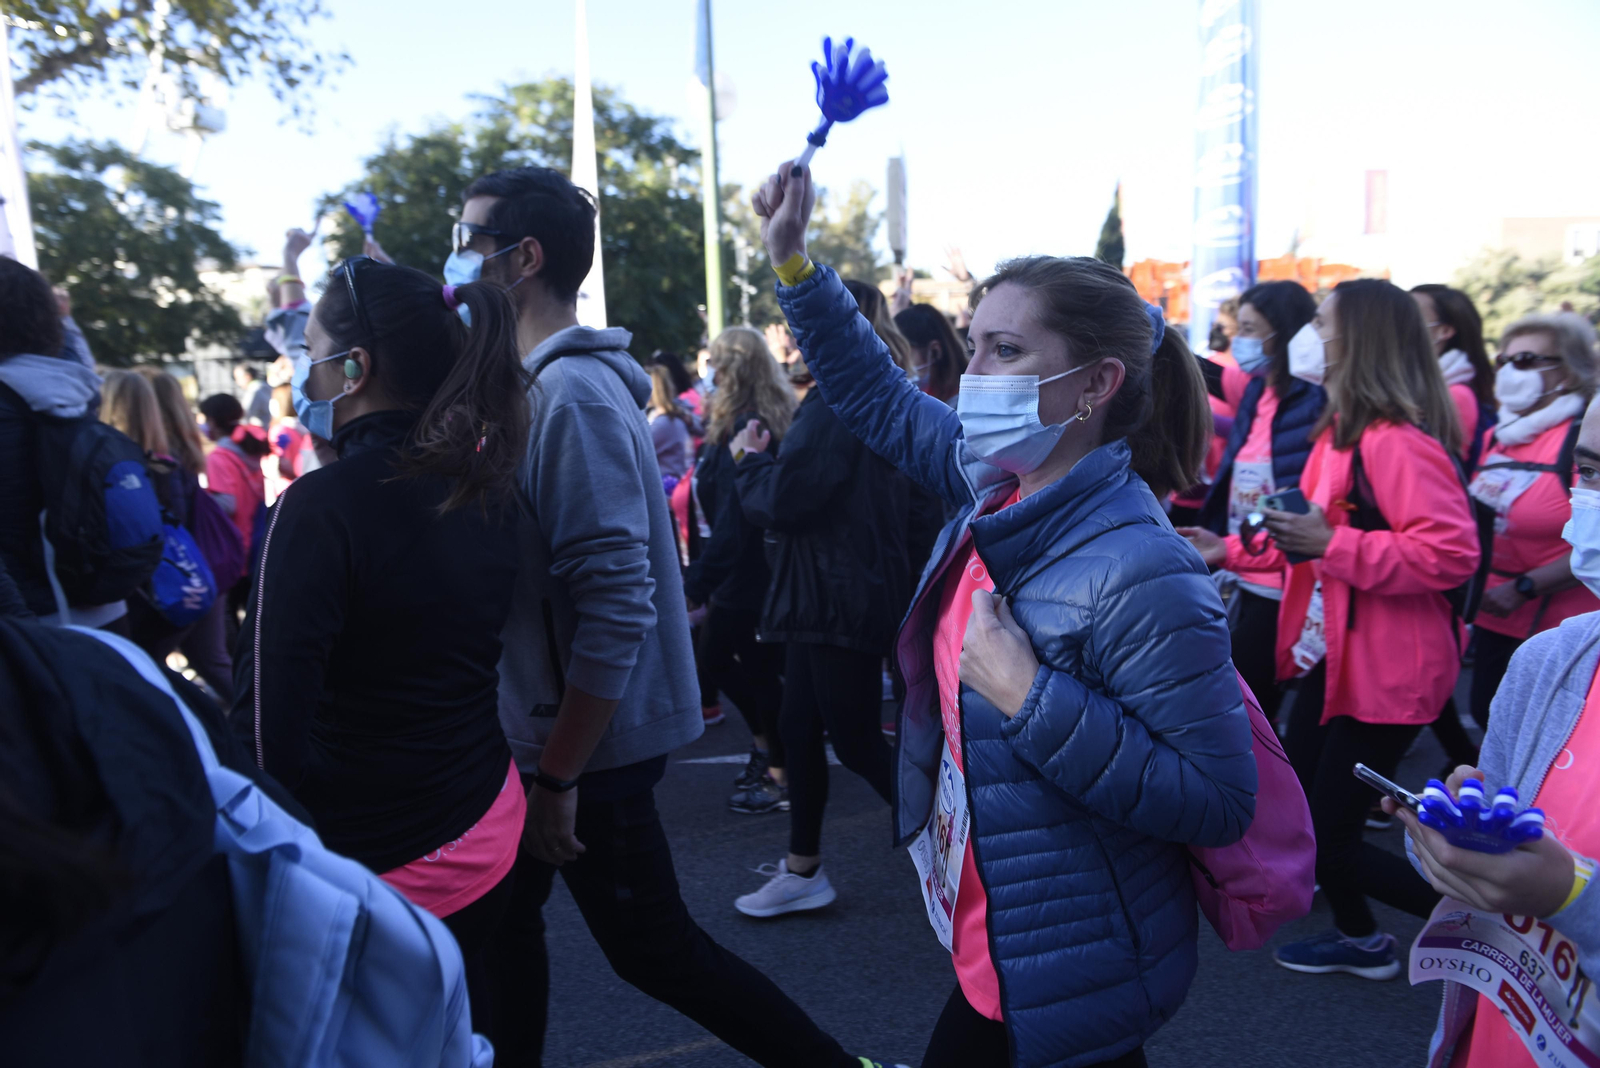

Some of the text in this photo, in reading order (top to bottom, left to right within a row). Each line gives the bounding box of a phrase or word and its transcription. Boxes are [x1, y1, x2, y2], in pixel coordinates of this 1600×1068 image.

[1419, 956, 1493, 984] OYSHO
[1519, 950, 1545, 982] 637
[1461, 939, 1519, 978] CARRERA
[1518, 975, 1534, 993] DE
[1531, 989, 1545, 1007] LA
[1541, 1004, 1574, 1045] MUJER
